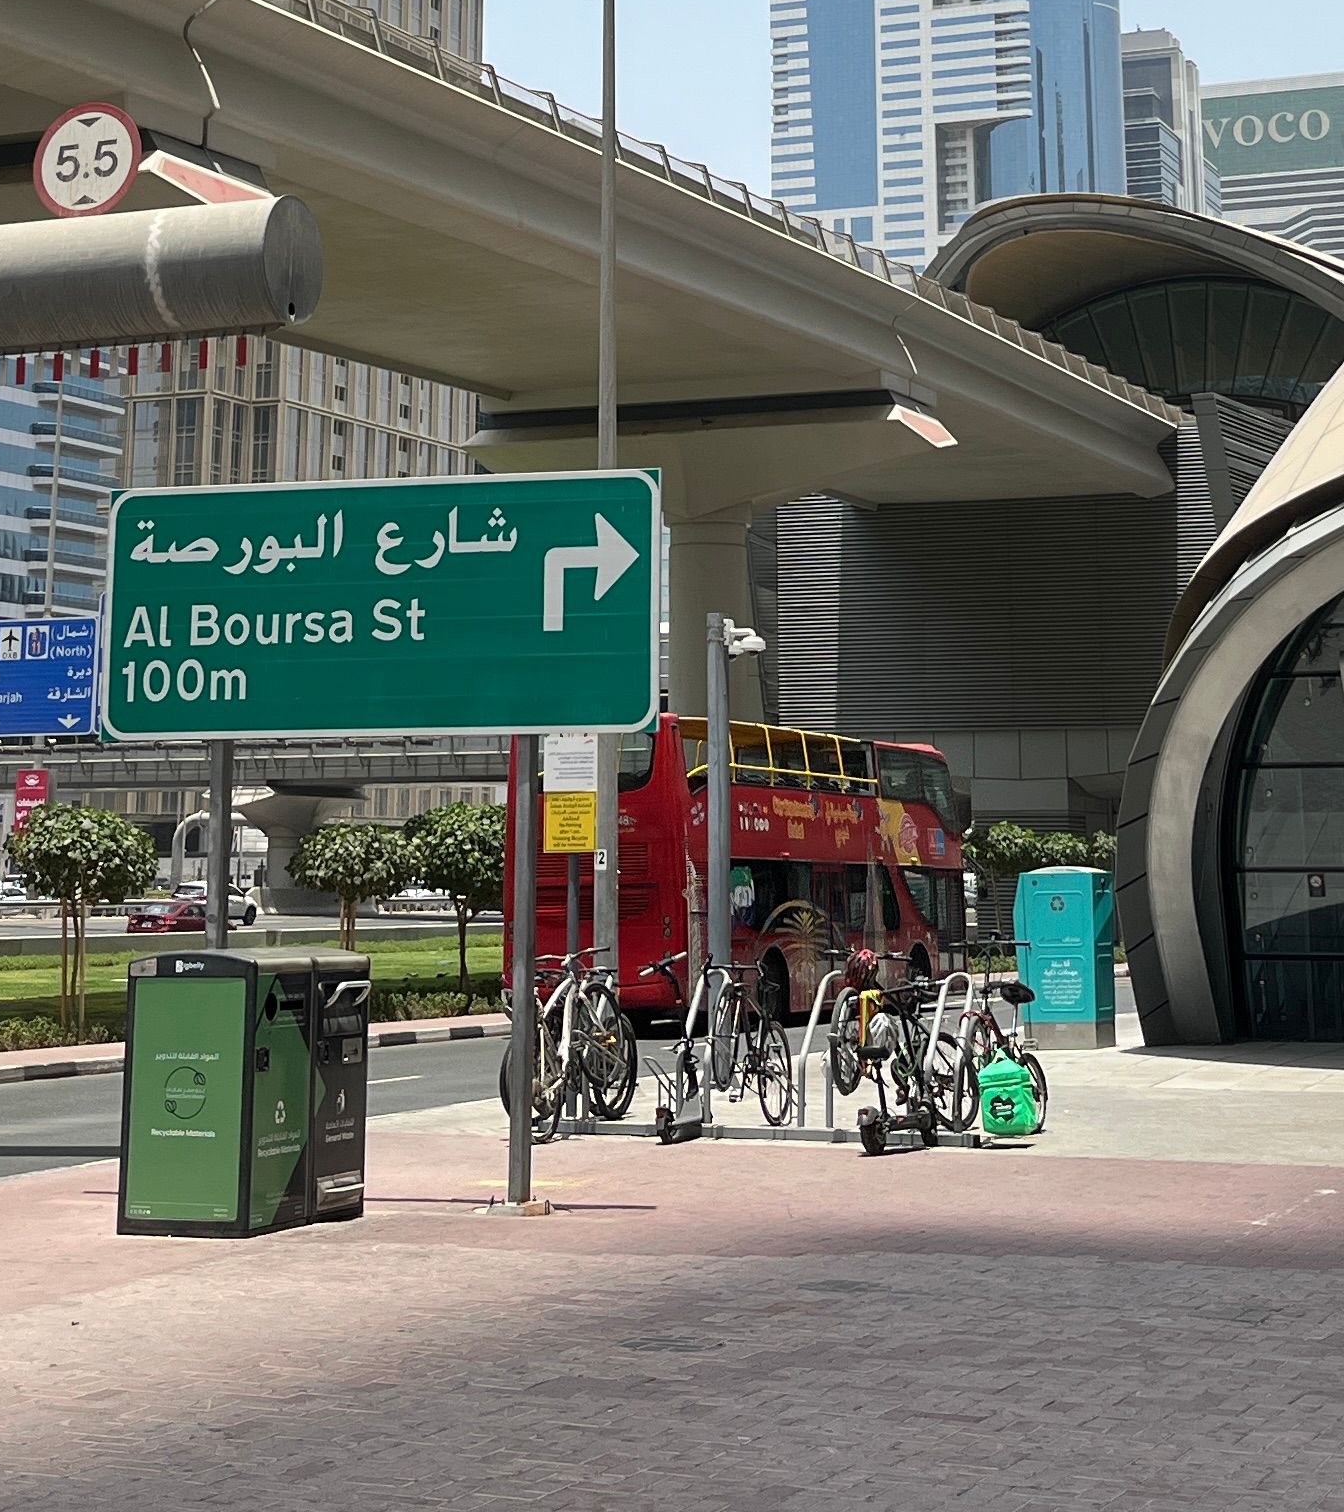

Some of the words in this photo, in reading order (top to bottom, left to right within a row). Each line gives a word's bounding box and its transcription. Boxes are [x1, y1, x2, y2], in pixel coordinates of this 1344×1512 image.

[56, 139, 119, 183] 5.5
[129, 508, 345, 575] البورصة
[374, 506, 518, 576] شارع
[123, 605, 173, 648] Al
[190, 603, 354, 647] Boursa
[371, 598, 426, 642] St
[49, 646, 93, 660] (North)
[67, 666, 92, 679] ديرة
[47, 686, 92, 703] الشارقة
[122, 658, 247, 703] 100m
